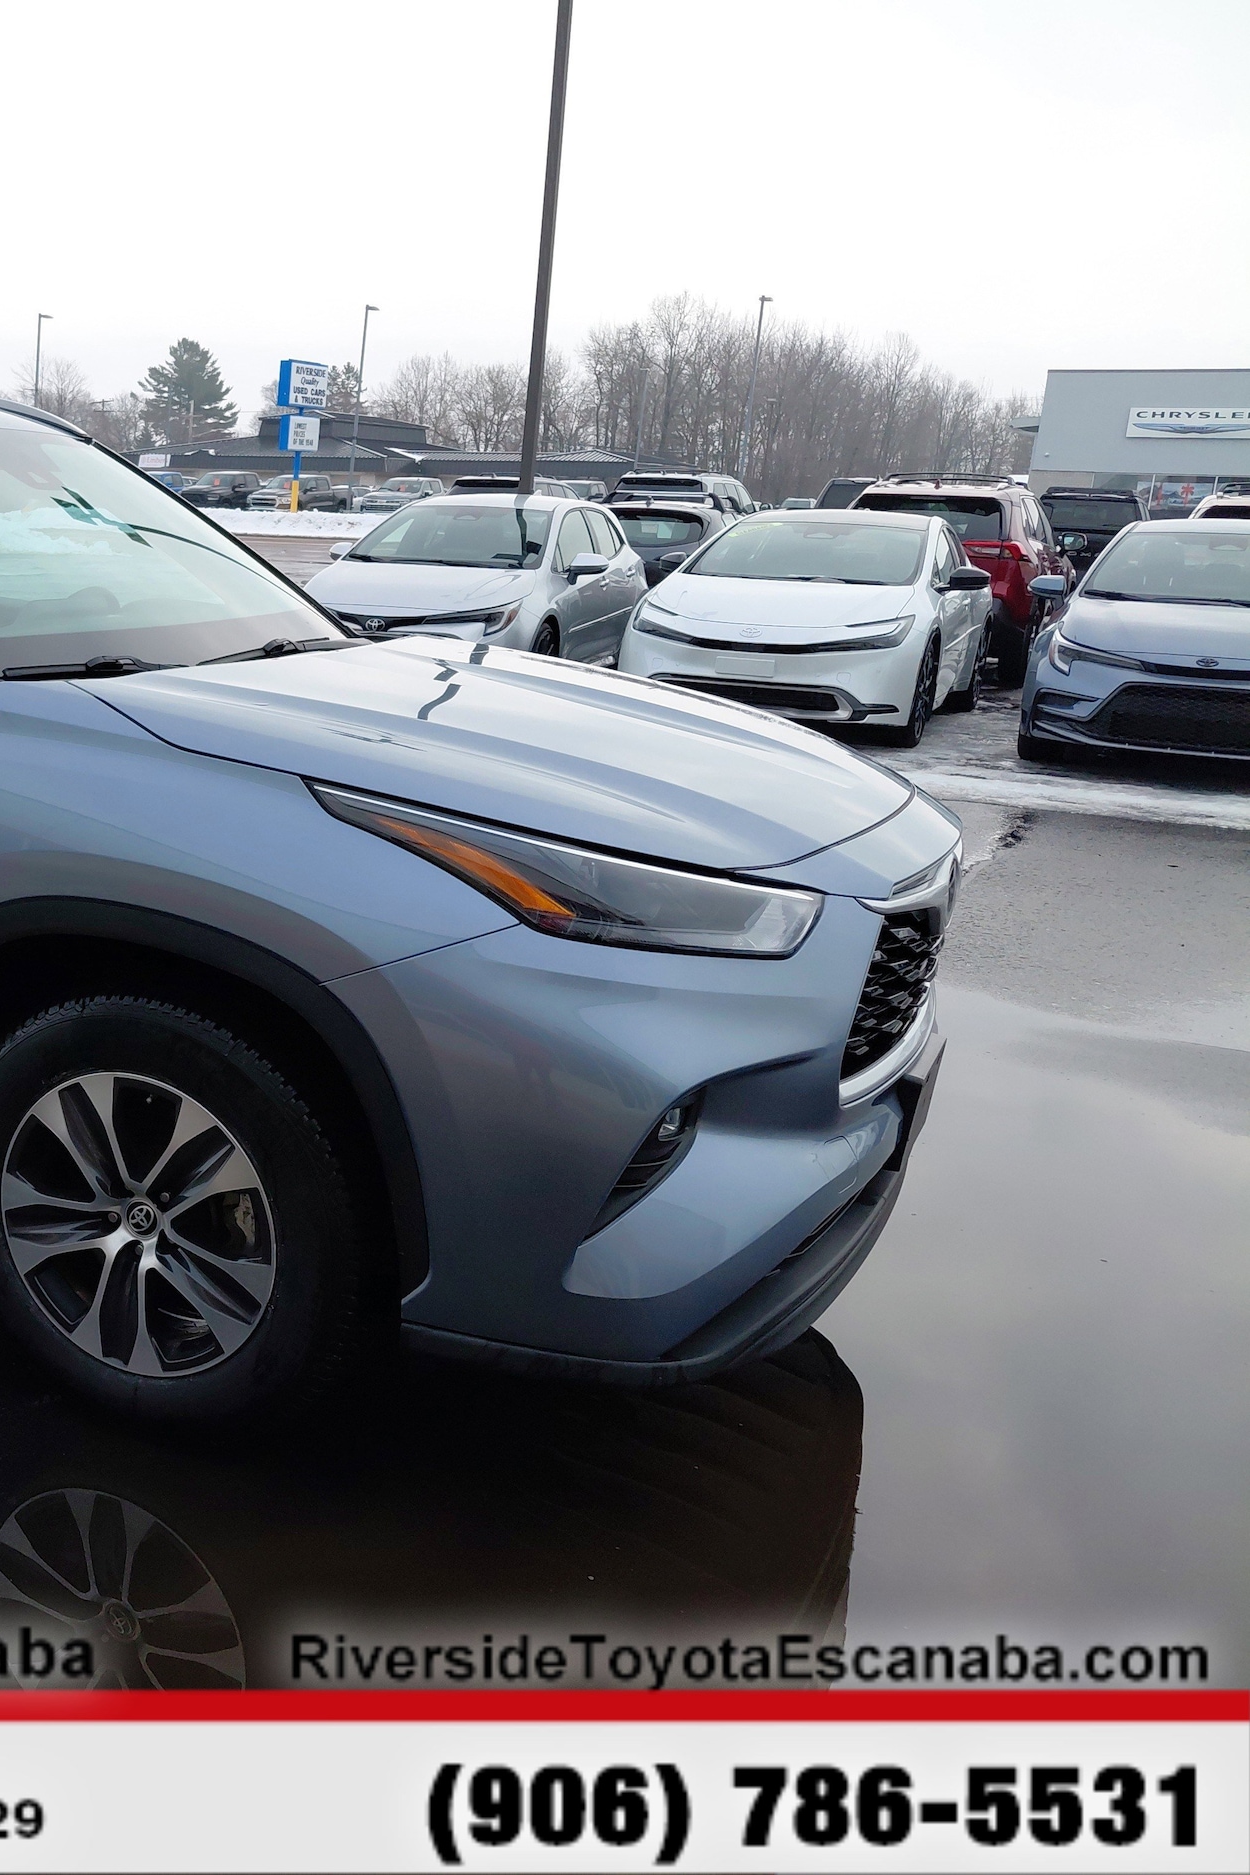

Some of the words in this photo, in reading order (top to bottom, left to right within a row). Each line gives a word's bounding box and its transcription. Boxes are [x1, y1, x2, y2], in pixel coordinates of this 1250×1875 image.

[296, 366, 326, 378] RIVERSIDE
[300, 376, 319, 388] Quality
[293, 386, 308, 395] USED
[310, 388, 326, 397] CARS
[294, 395, 299, 403] &
[301, 396, 324, 406] TRUCKS
[1136, 411, 1250, 419] CHRYSLE
